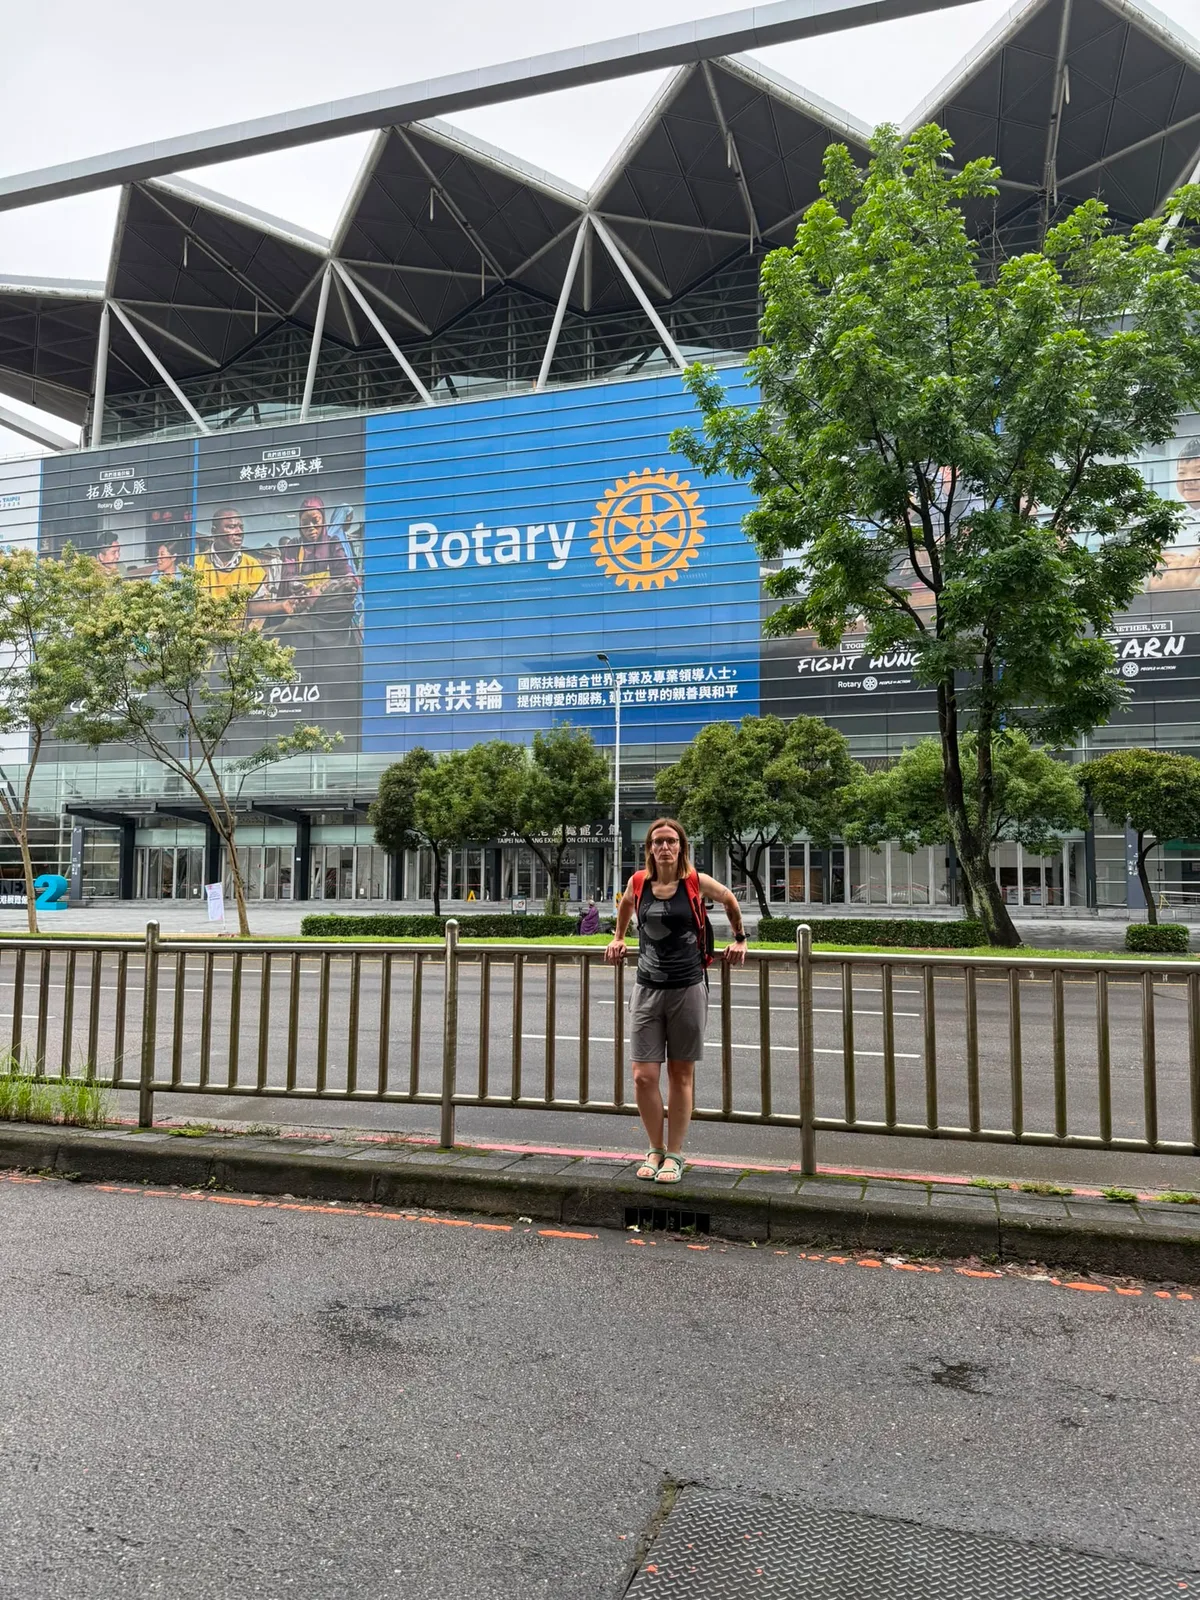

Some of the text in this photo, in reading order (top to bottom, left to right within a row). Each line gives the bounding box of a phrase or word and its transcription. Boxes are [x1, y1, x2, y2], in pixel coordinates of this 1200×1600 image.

[239, 457, 324, 481] 終結小兒麻痺
[86, 479, 147, 499] 拓展人脈
[97, 502, 113, 510] Rotary
[408, 522, 576, 570] Rotary
[1108, 635, 1185, 658] EARN
[797, 655, 862, 673] FIGHT
[269, 685, 320, 703] POLIO
[837, 680, 862, 690] Rotary
[386, 679, 503, 714] 國際扶輪
[34, 874, 68, 910] 2
